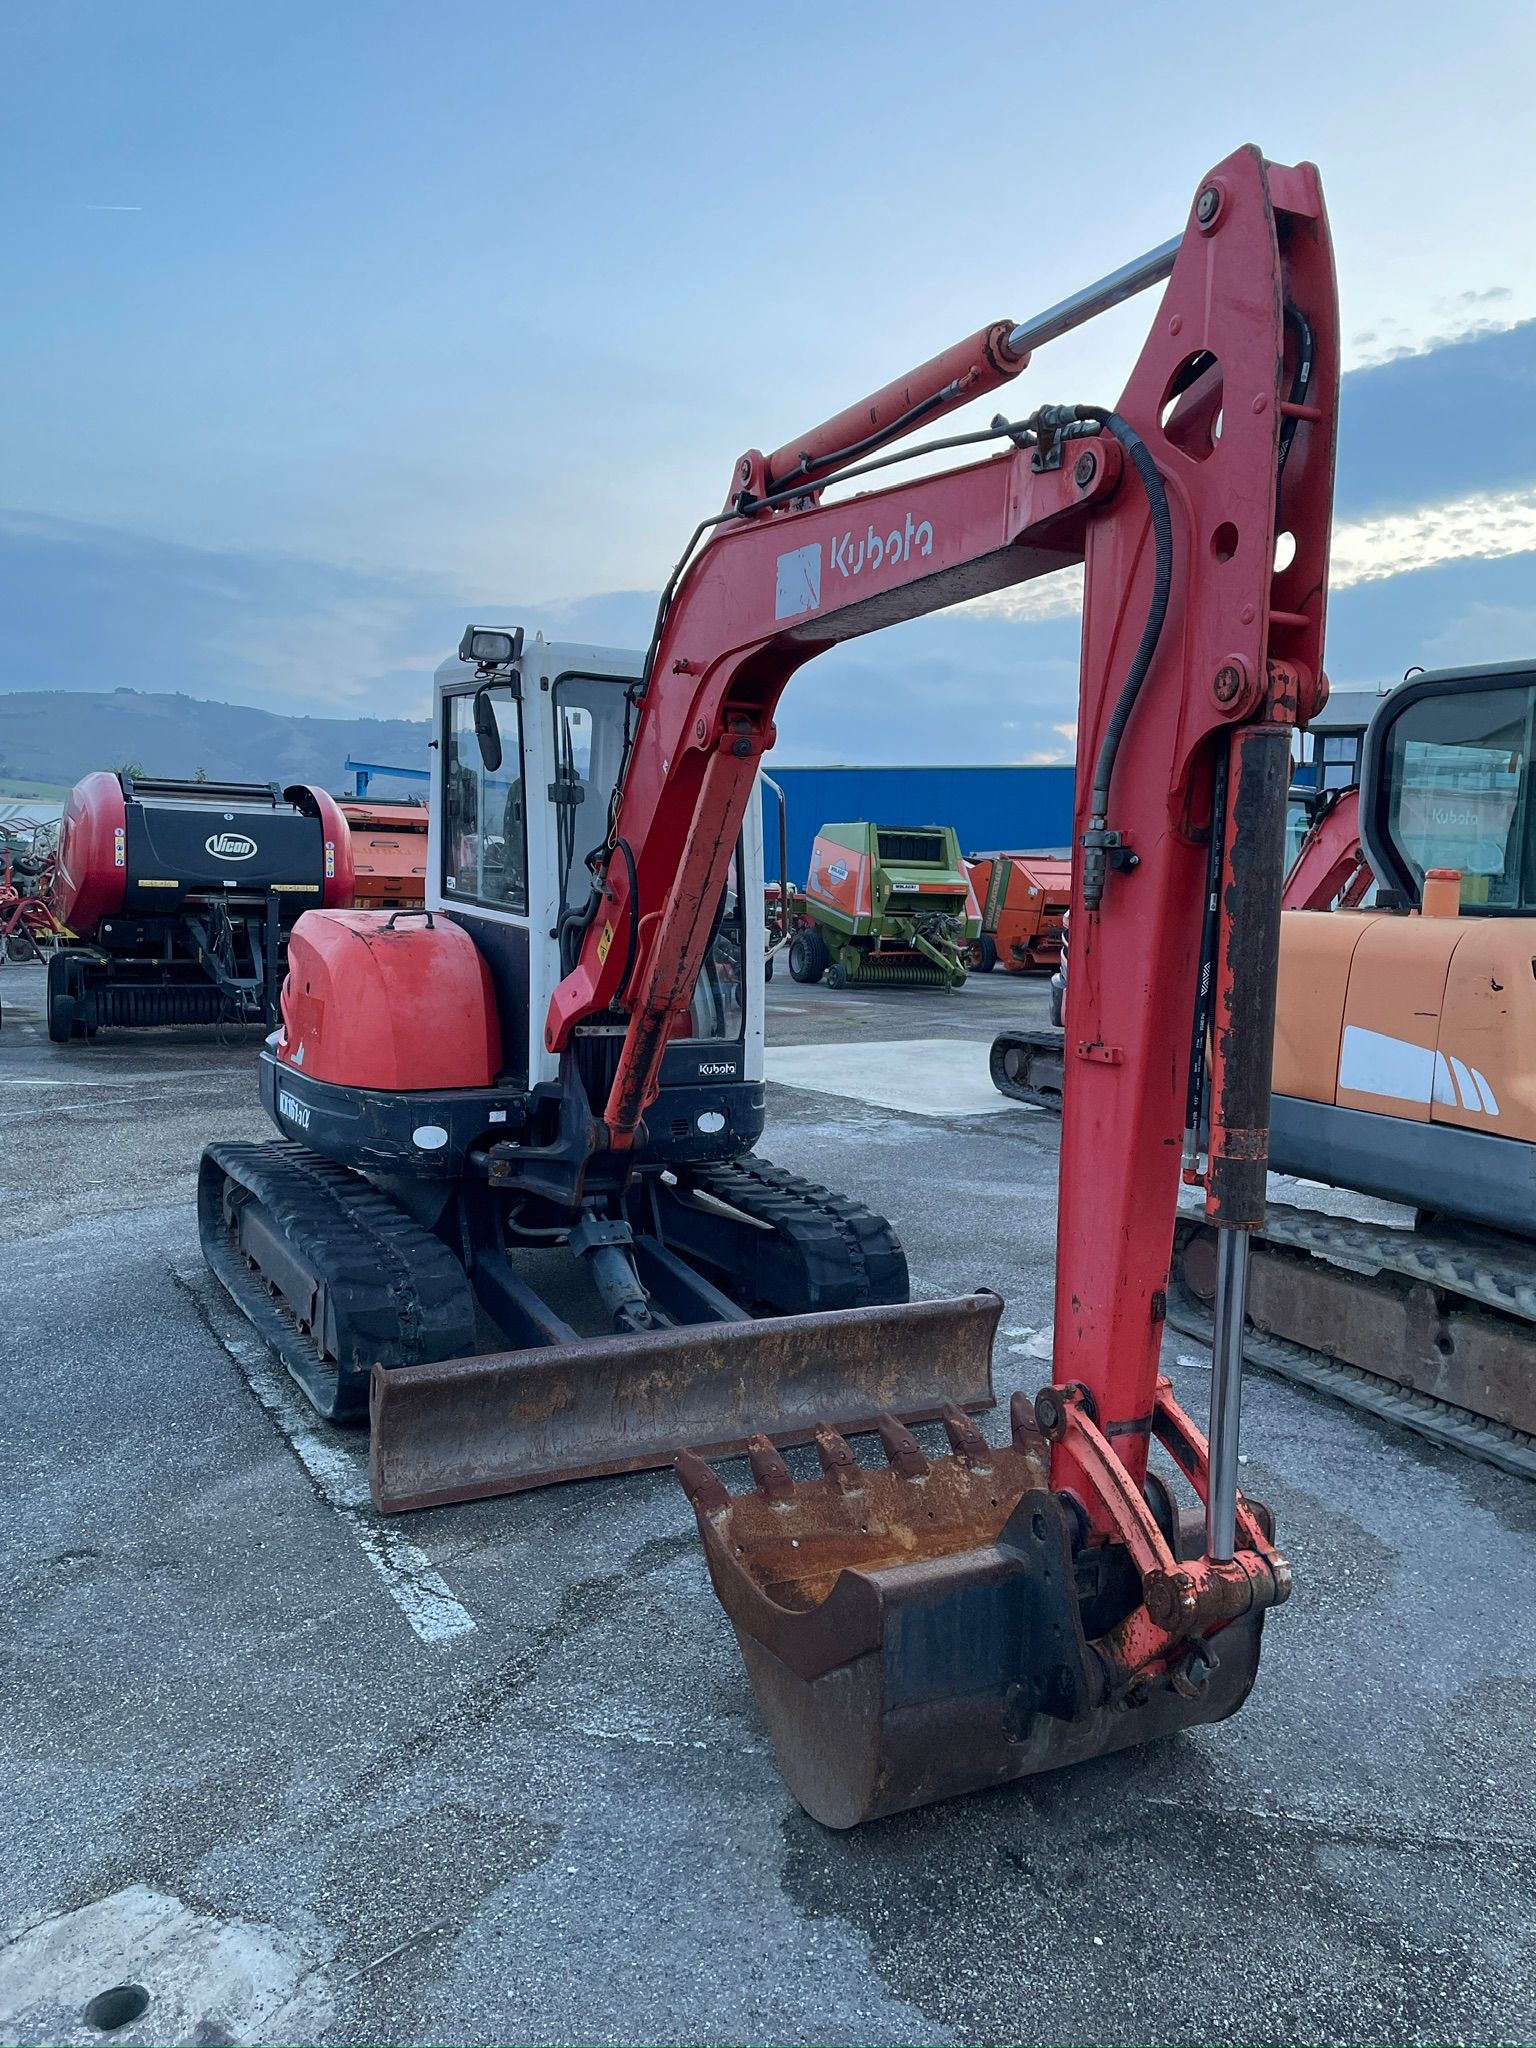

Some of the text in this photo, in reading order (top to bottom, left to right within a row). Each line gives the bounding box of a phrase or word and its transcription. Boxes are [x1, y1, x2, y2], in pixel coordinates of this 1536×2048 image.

[831, 512, 933, 577] Kubota
[1432, 807, 1478, 825] Kubota
[213, 834, 251, 854] Vicon
[700, 1063, 735, 1075] Kubota
